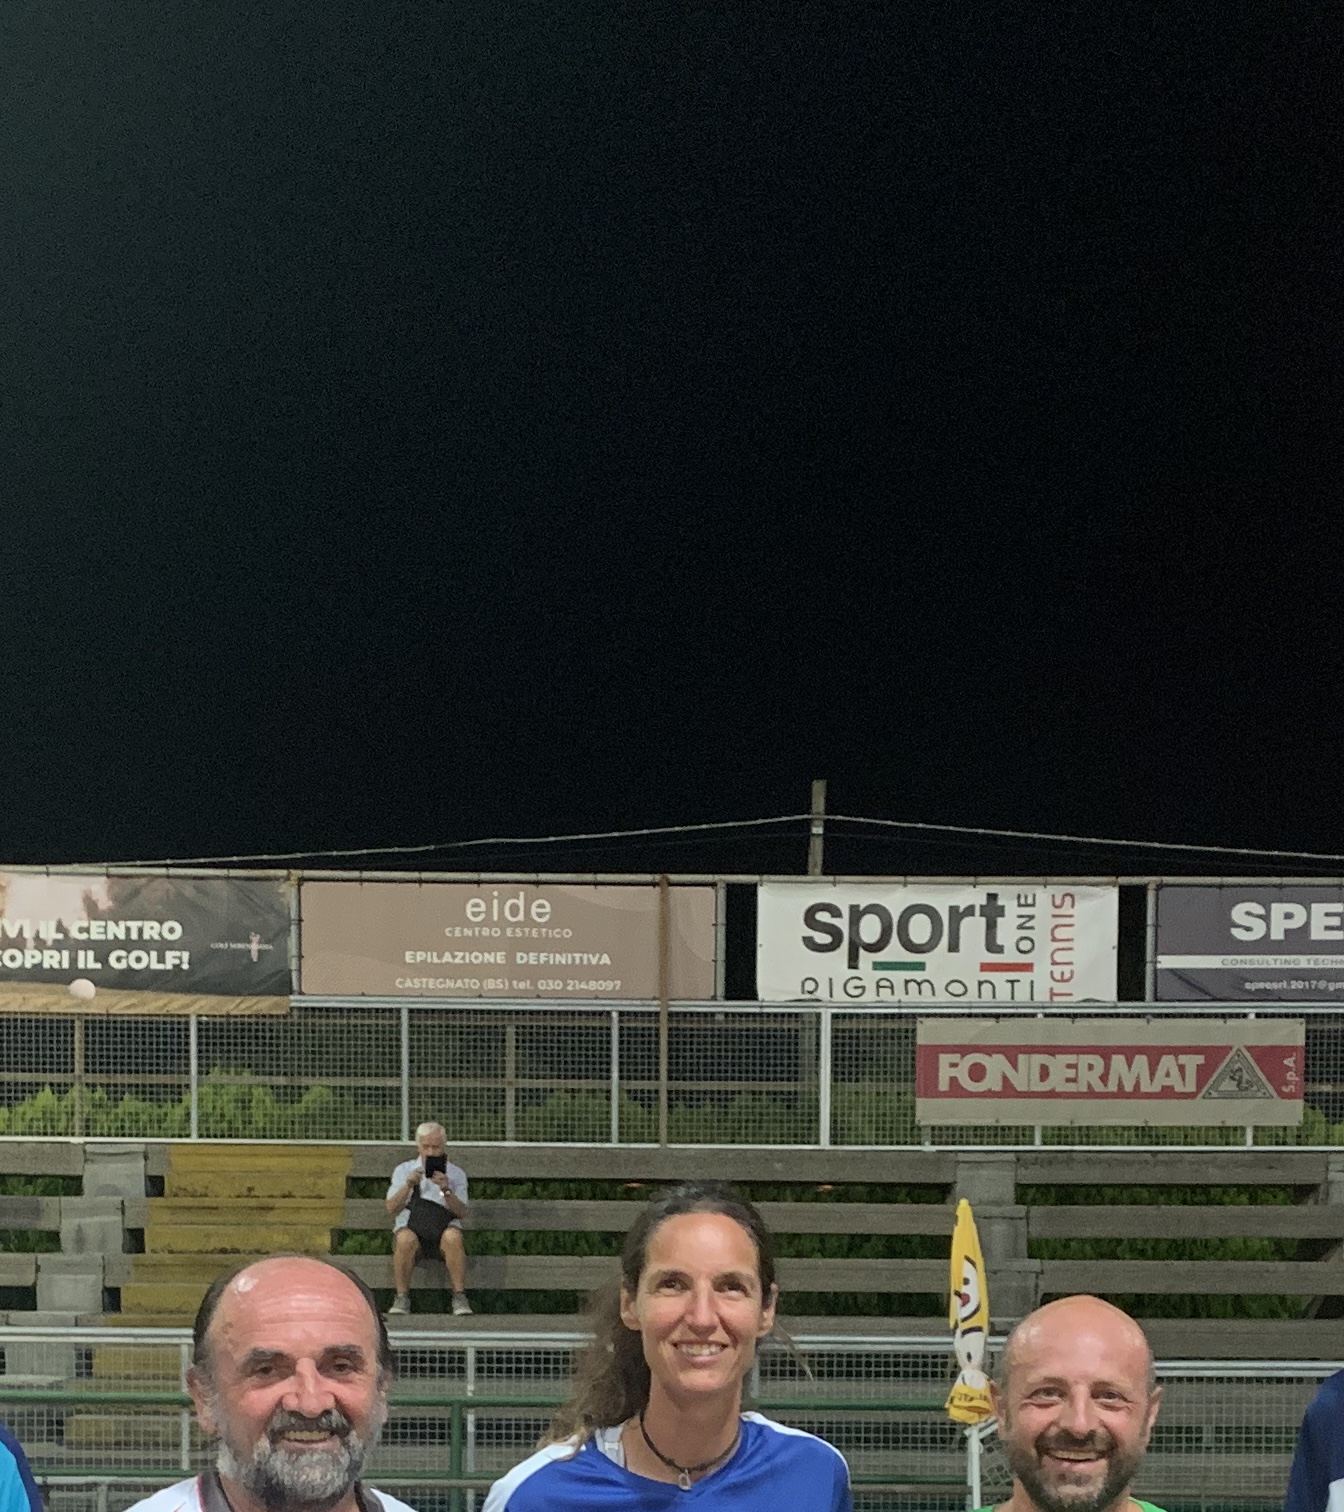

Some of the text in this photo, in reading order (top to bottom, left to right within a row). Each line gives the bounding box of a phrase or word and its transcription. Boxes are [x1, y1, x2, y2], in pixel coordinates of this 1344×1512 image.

[465, 891, 552, 923] eide
[70, 919, 183, 941] CENTRO
[444, 927, 573, 938] CENTRO ESTETICO
[801, 892, 1006, 970] sport
[1015, 892, 1037, 955] ONE
[77, 950, 102, 970] IL
[108, 949, 190, 971] GOLF!
[405, 951, 612, 965] EPILAZIONE DEFINITIVA
[395, 977, 480, 990] CASTEGNATO
[938, 1053, 1204, 1093] FONDERMAT
